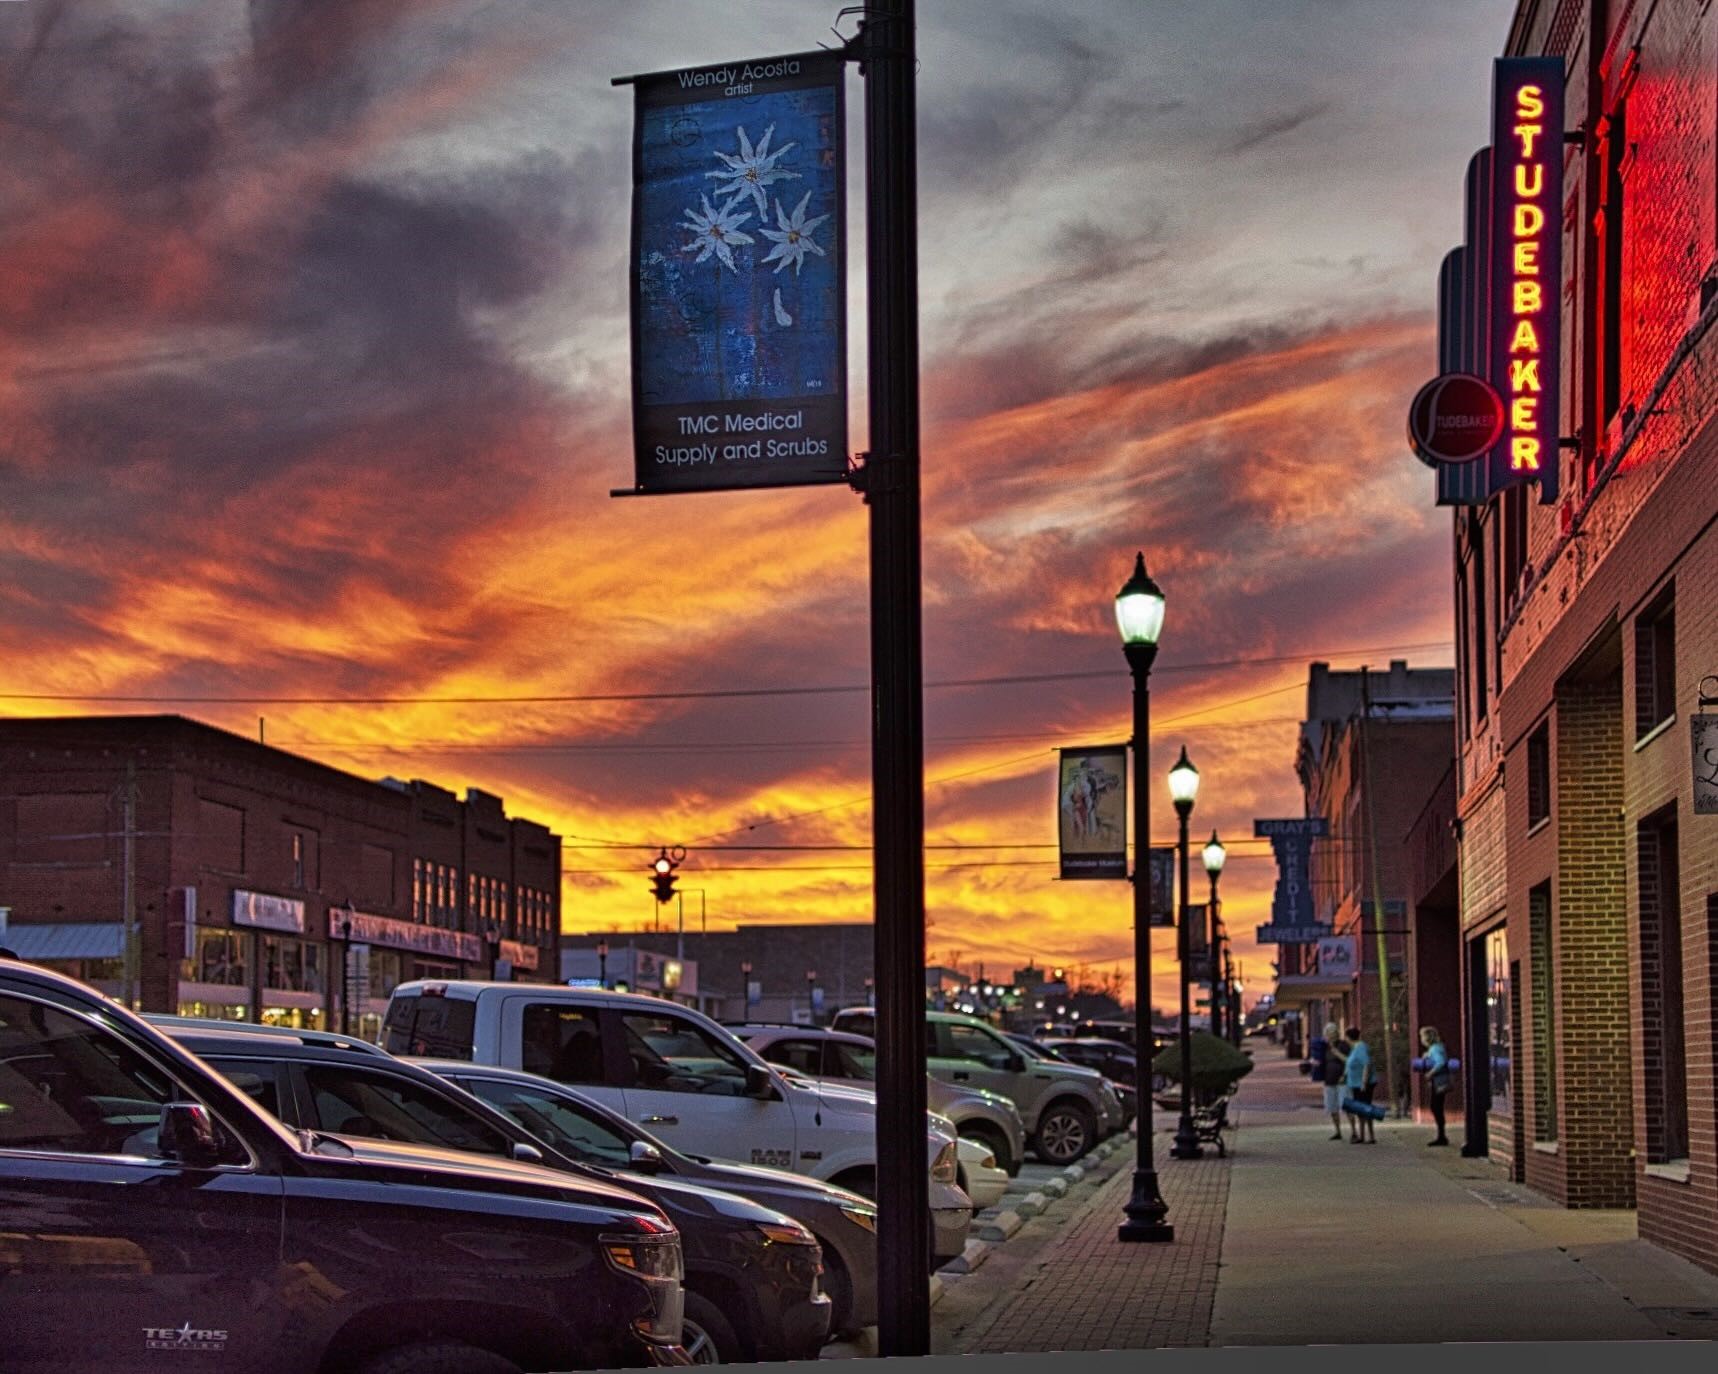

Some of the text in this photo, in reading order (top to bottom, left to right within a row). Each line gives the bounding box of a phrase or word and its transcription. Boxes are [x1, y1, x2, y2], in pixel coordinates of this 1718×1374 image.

[678, 59, 801, 89] Wendy Acosta
[724, 82, 753, 96] artist
[1510, 85, 1544, 471] STUDEBAKER
[678, 411, 802, 435] TMC Medical
[656, 437, 828, 466] Supply and Scrubs
[1262, 821, 1321, 834] GRAY'S
[1286, 838, 1300, 923] CREDIT
[142, 1322, 228, 1342] TEXAS
